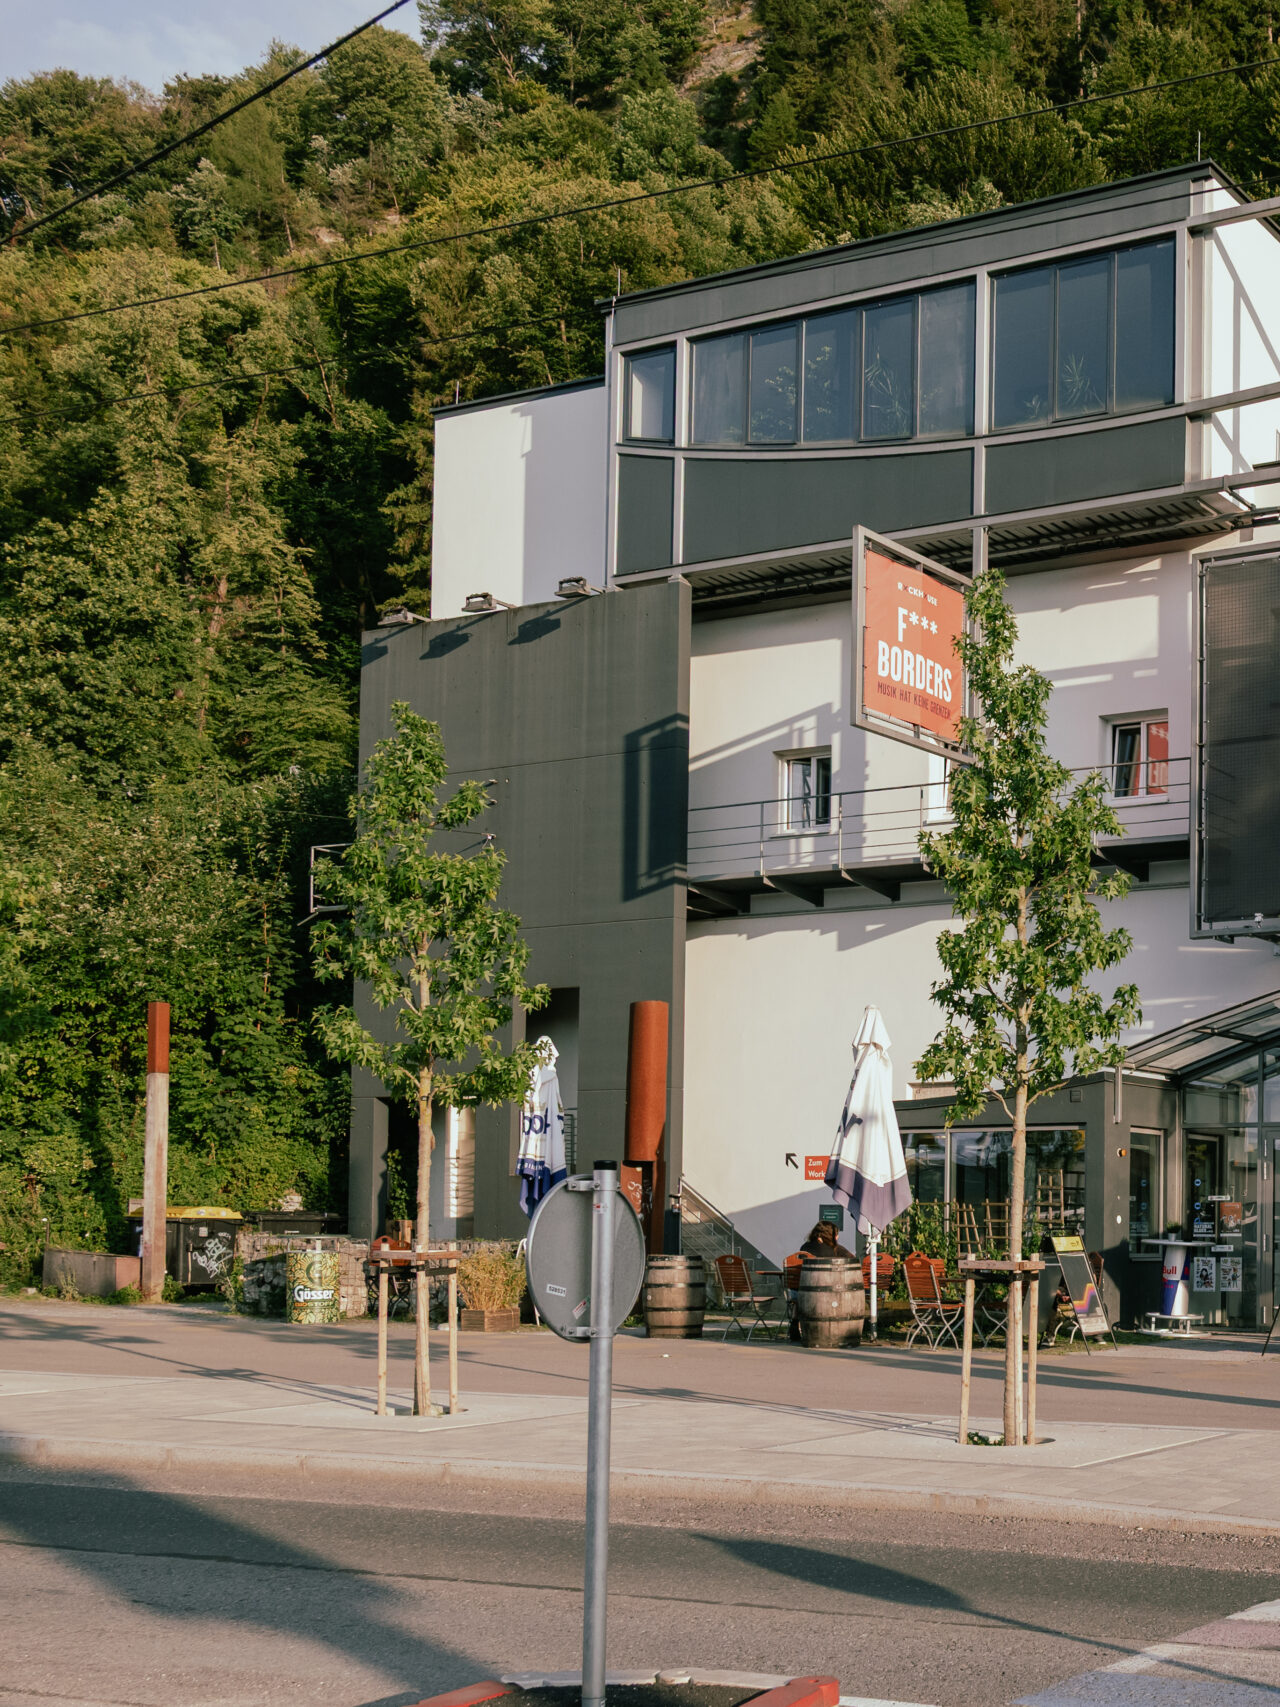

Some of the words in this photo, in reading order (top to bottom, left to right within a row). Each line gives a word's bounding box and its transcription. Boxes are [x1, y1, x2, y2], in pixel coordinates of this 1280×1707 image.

[877, 639, 953, 703] BORDERS
[877, 680, 897, 699] MUSIK
[899, 689, 911, 703] HAT
[914, 693, 929, 710] KEINE
[808, 1158, 823, 1167] Zum
[294, 1285, 335, 1303] Gösser
